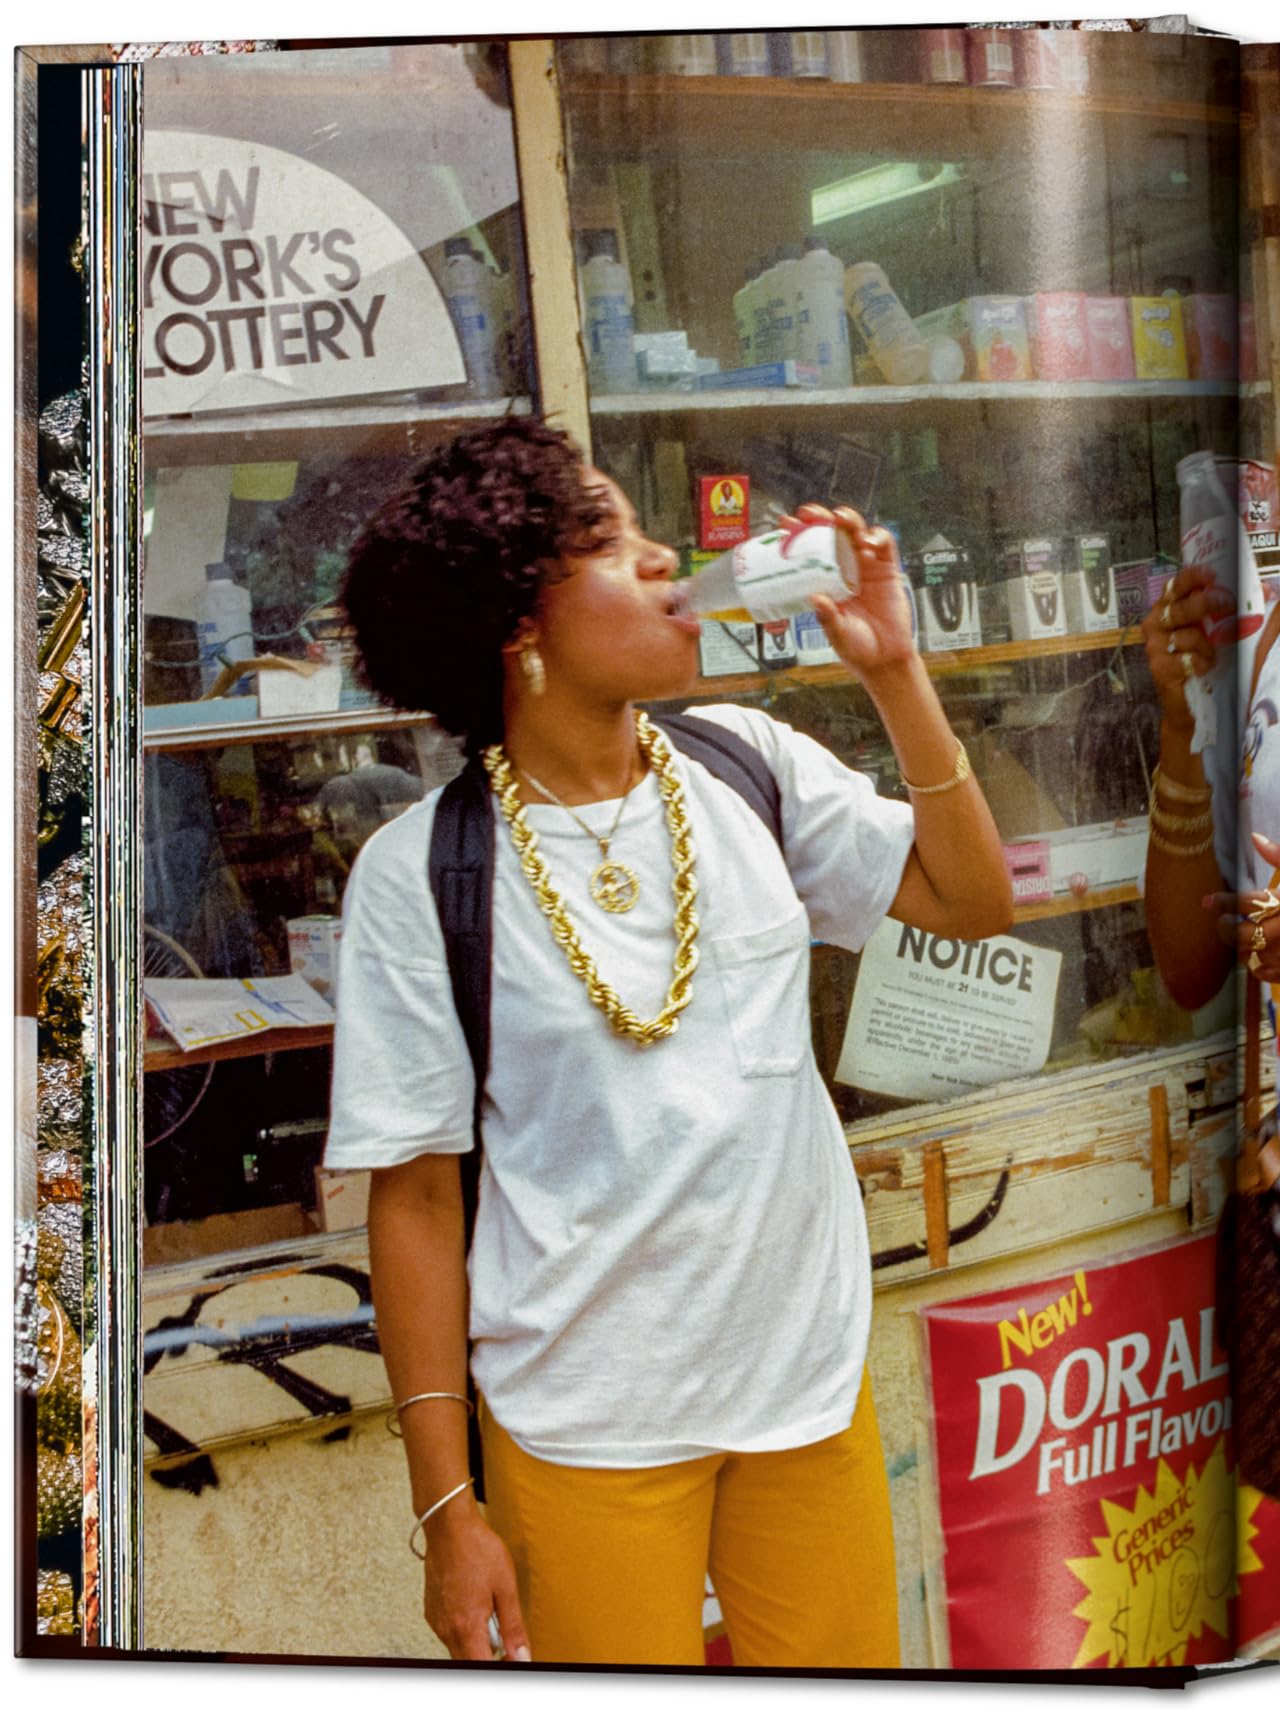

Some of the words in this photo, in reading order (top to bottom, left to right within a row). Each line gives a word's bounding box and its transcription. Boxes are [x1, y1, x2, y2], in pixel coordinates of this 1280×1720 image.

[896, 923, 1033, 993] NOTICE
[997, 1270, 1093, 1368] New!
[969, 1308, 1230, 1480] DORAL
[1036, 1425, 1117, 1496] Full
[1112, 1485, 1193, 1564] Generic
[1127, 1524, 1194, 1586] Prices
